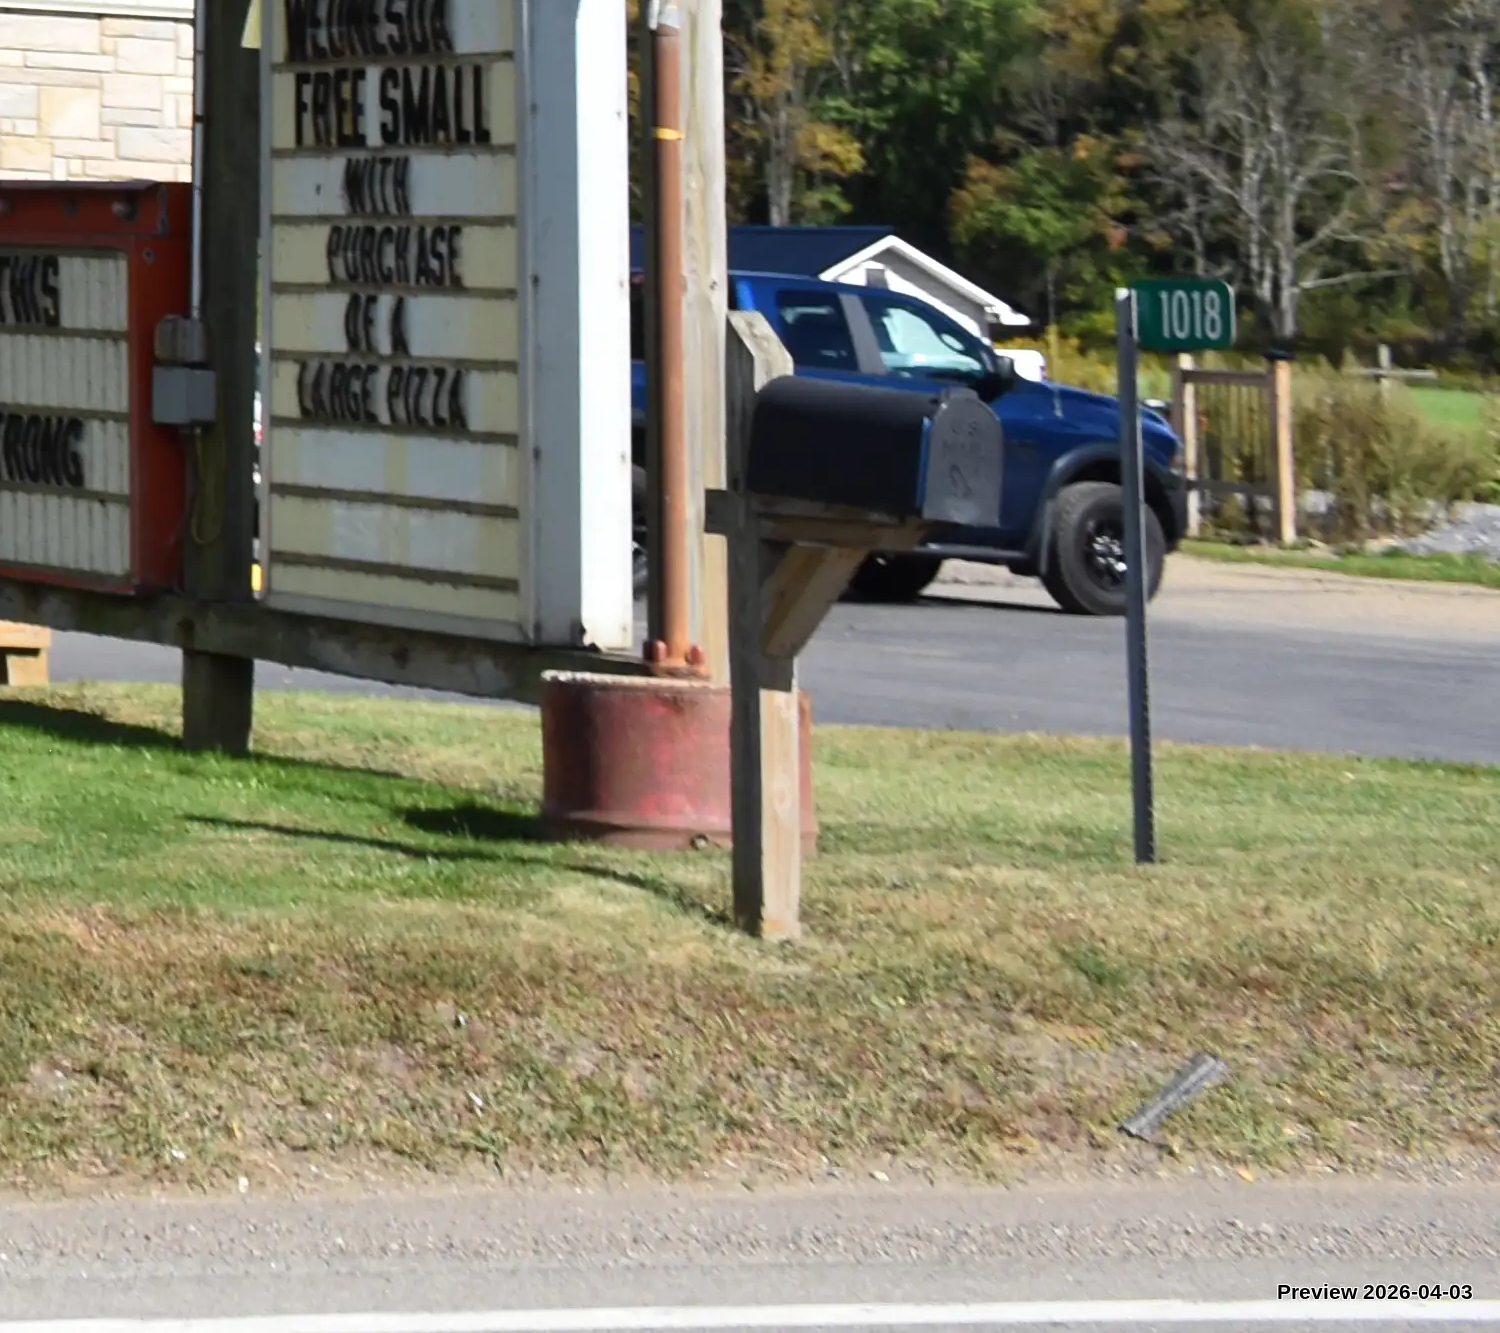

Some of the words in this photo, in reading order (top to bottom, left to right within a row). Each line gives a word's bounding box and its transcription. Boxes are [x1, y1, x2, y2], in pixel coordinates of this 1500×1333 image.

[295, 68, 368, 147] FREE
[379, 64, 490, 145] SMALL
[344, 156, 412, 215] WITH
[327, 225, 465, 287] PURCHASE
[344, 293, 379, 353] OF
[390, 295, 411, 356] A
[1159, 289, 1223, 340] 1018
[297, 361, 381, 424] LARGE
[386, 366, 469, 430] PIZZA
